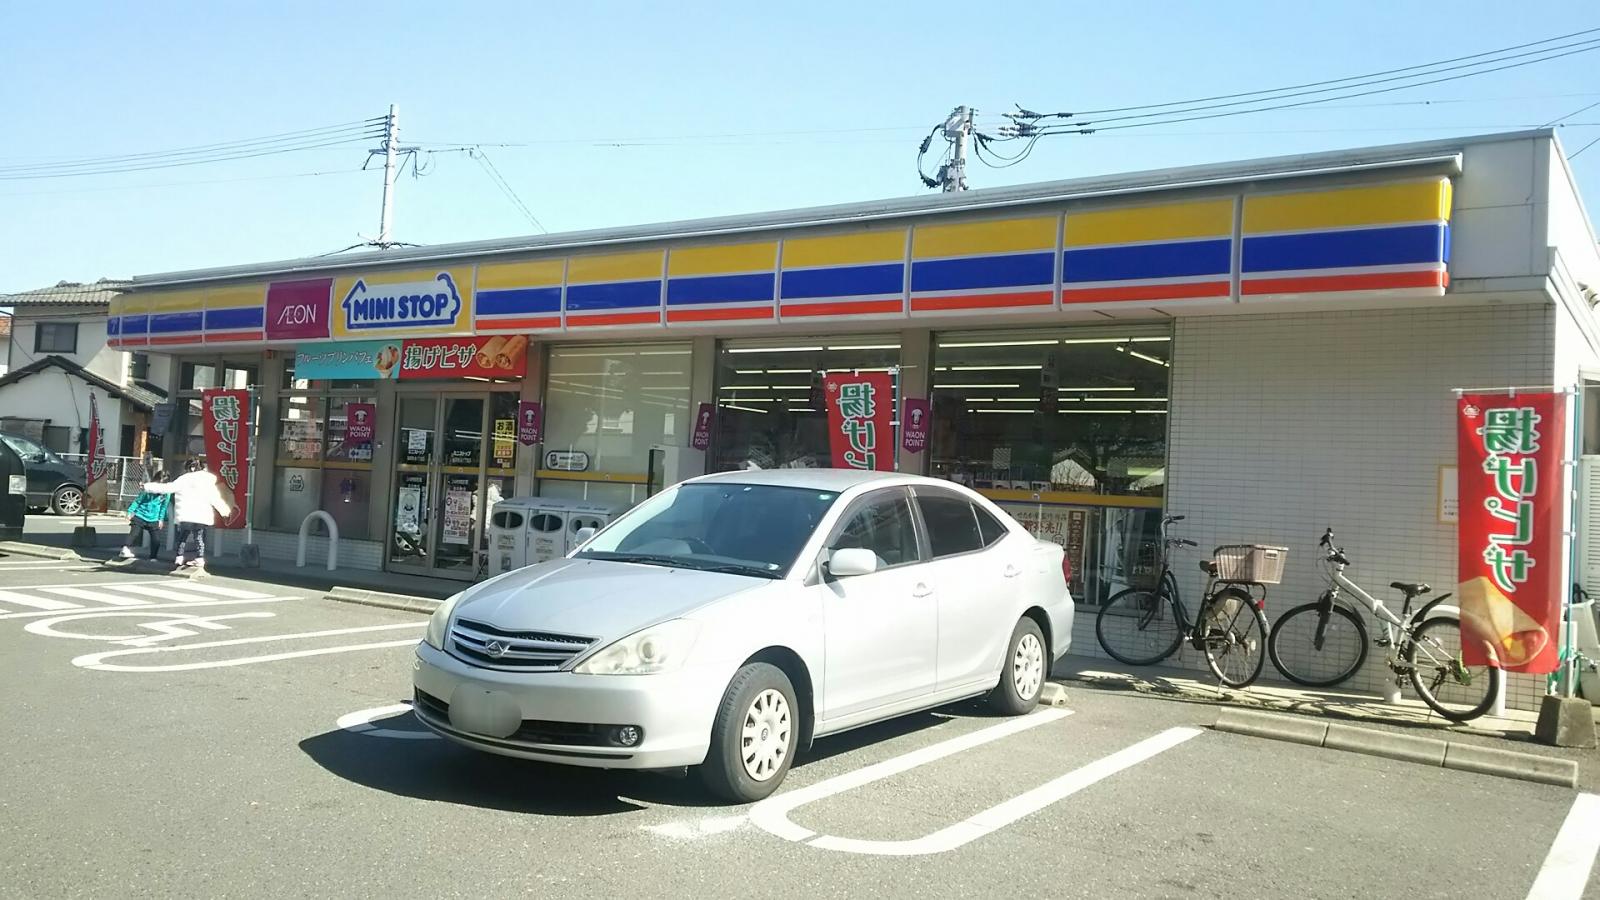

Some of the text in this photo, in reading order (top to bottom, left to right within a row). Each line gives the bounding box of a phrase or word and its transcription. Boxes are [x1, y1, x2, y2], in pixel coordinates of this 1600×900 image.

[354, 293, 449, 321] MINI STOP
[403, 343, 477, 370] 揚げピザ
[521, 427, 538, 435] WAON
[904, 430, 925, 439] WAON
[520, 433, 537, 441] POINT
[904, 438, 925, 447] POINT
